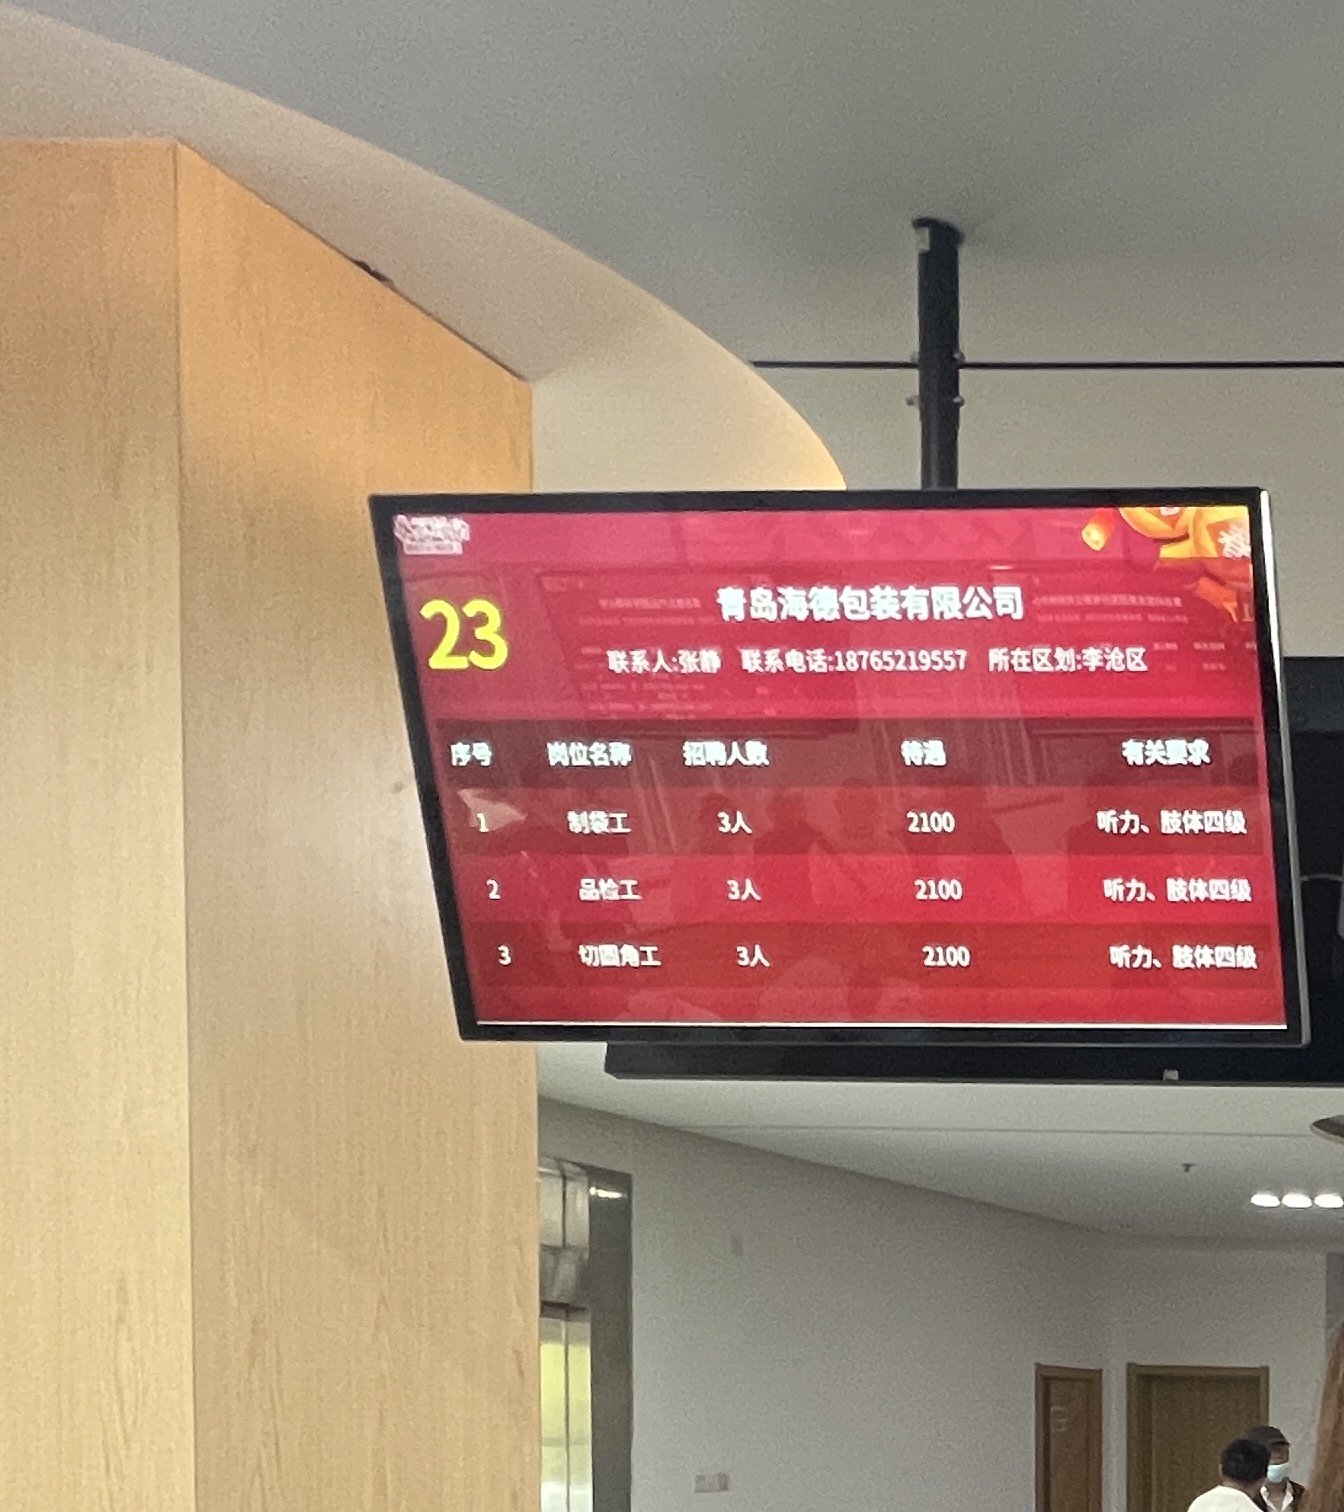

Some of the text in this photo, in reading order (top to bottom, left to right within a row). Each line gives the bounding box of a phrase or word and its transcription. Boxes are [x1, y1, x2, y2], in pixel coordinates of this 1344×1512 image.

[716, 584, 1024, 622] 青岛海德包装有限公司
[422, 597, 509, 670] 23
[739, 648, 968, 674] 联系电话:18765219557
[988, 646, 1148, 672] 所在区划:李沧区
[450, 738, 1211, 767] 序号 岗位名称 招聘人数 待遇 有关要求
[476, 812, 490, 833] 1
[717, 810, 753, 834] 3人
[906, 810, 956, 833] 2100
[486, 879, 501, 900] 2
[579, 878, 642, 901] 品检工
[726, 878, 762, 901] 3人
[914, 878, 963, 900] 2100
[498, 945, 512, 965] 3
[736, 944, 770, 967] 3人
[922, 946, 970, 967] 2100
